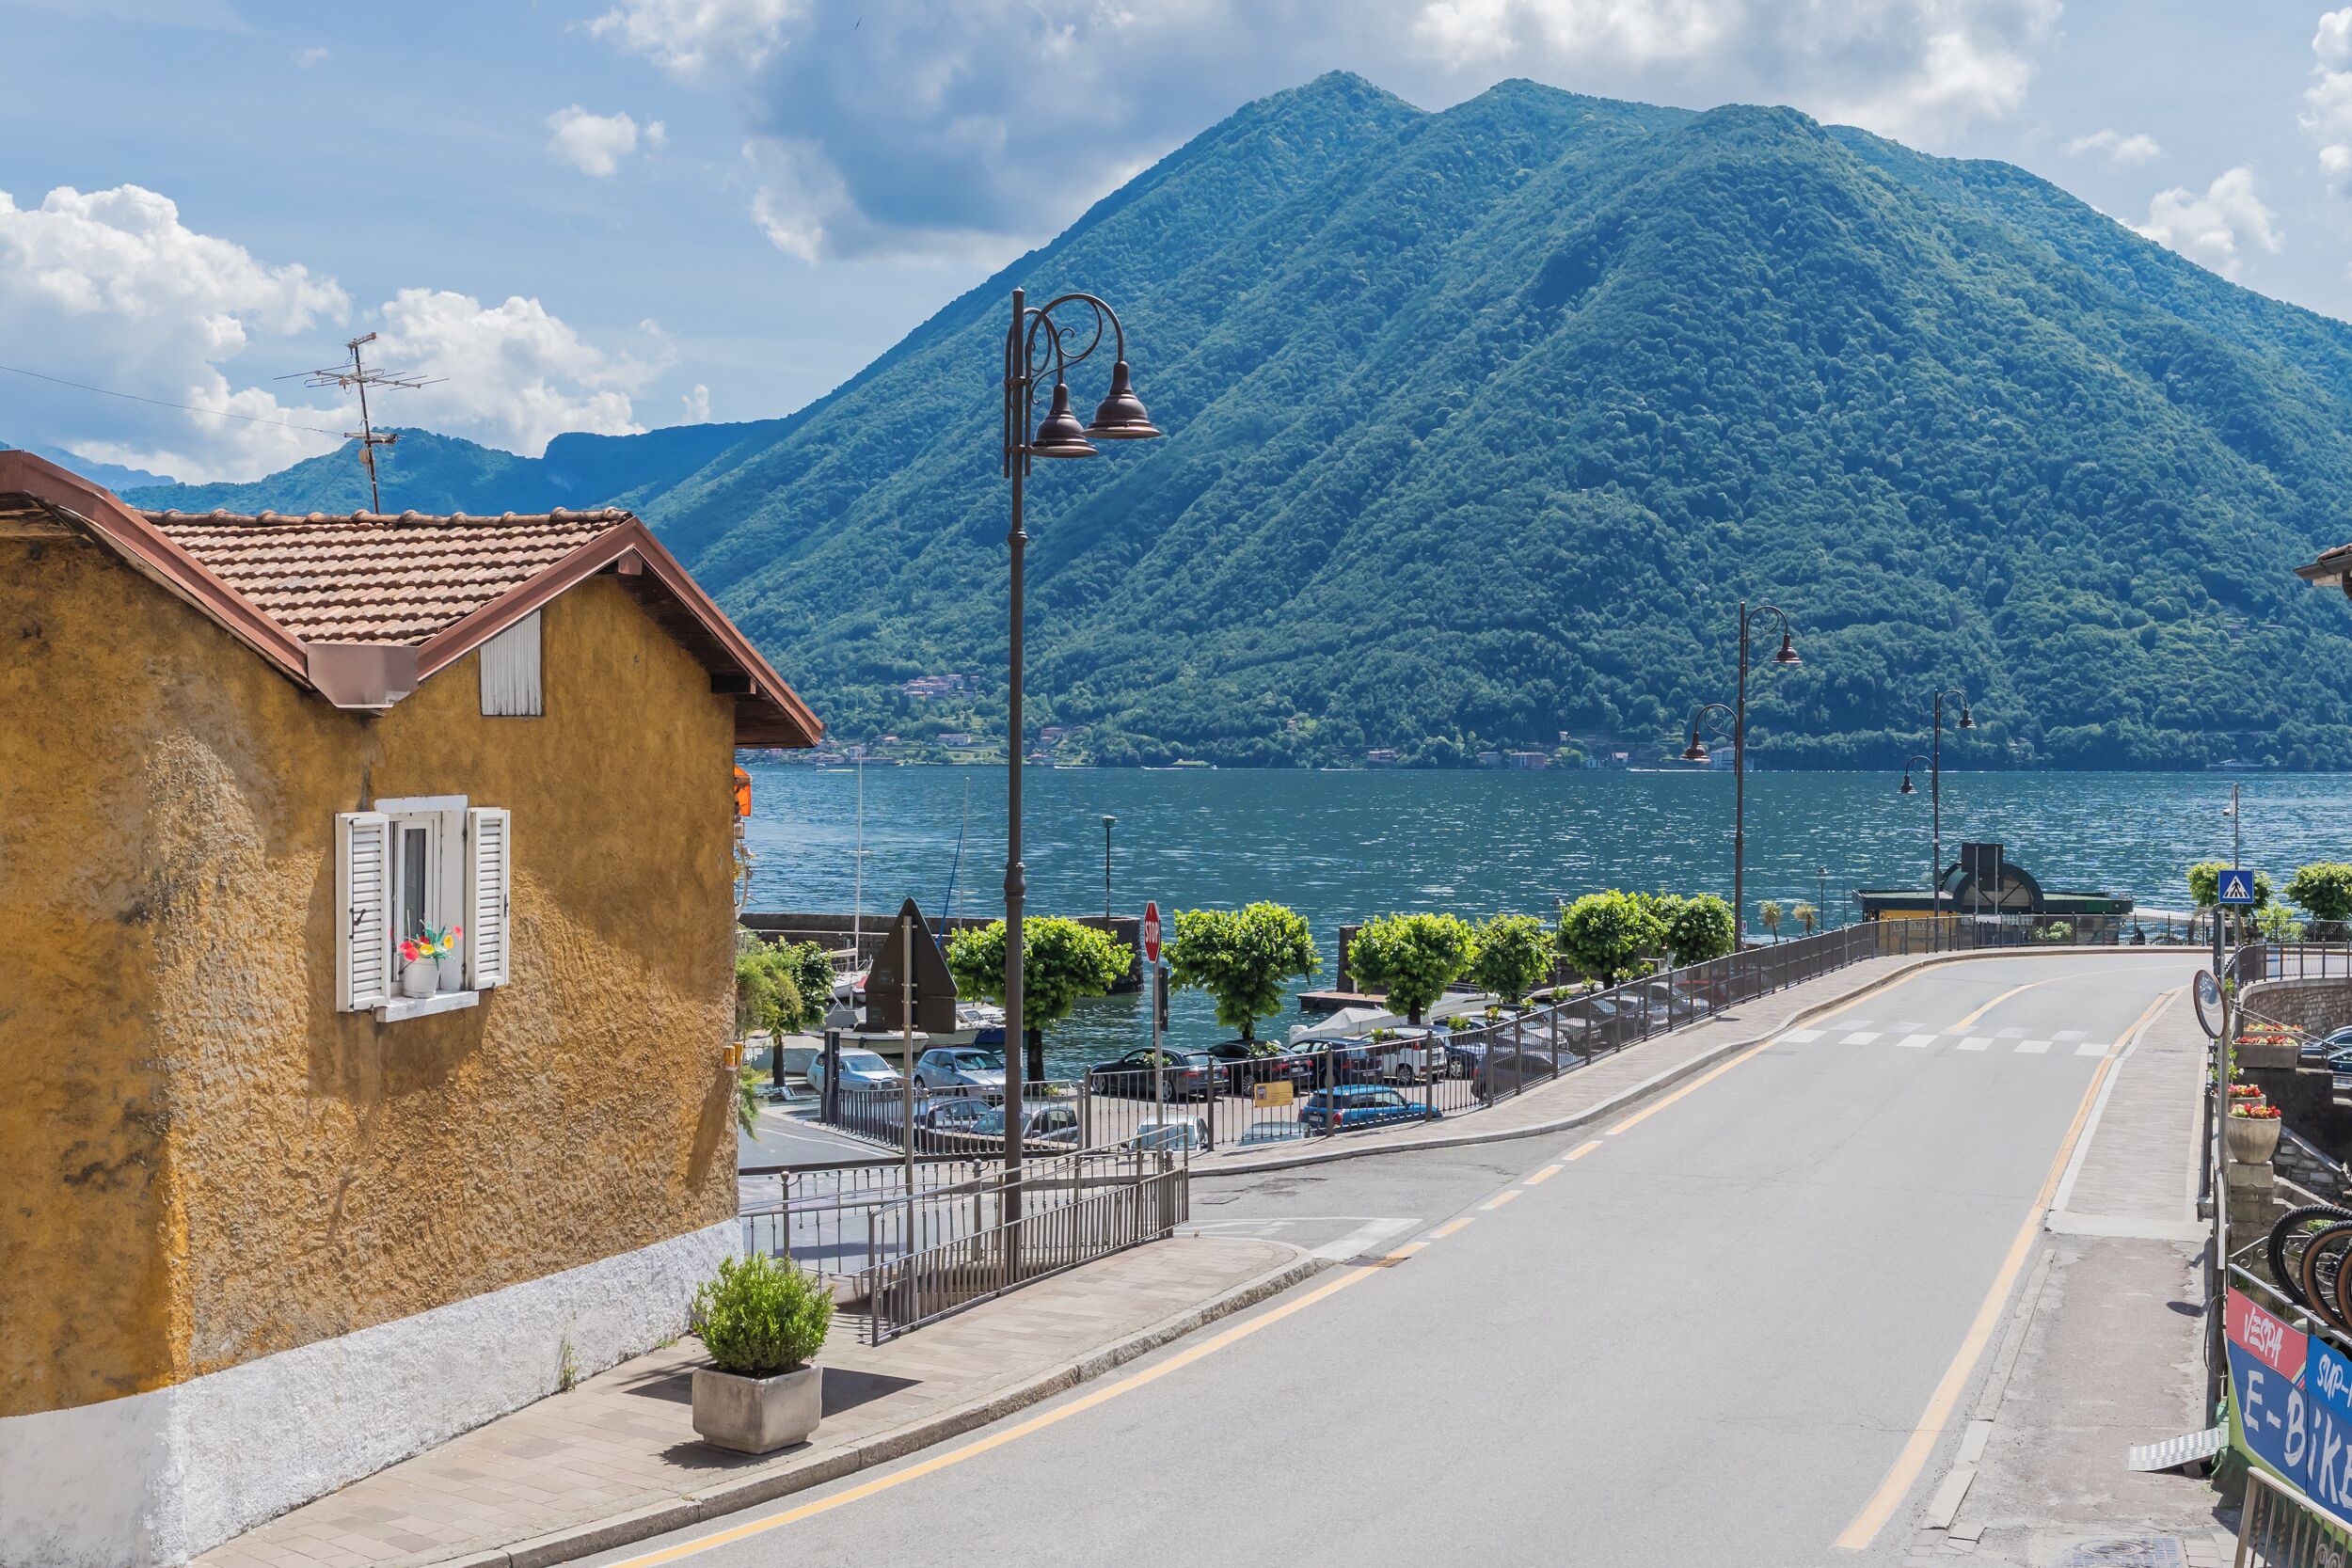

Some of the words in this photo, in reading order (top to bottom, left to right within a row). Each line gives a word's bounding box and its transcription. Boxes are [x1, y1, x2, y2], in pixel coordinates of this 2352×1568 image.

[1145, 921, 1158, 943] STOP
[2243, 1307, 2283, 1367] VESPA
[2316, 1354, 2352, 1408] SUP-
